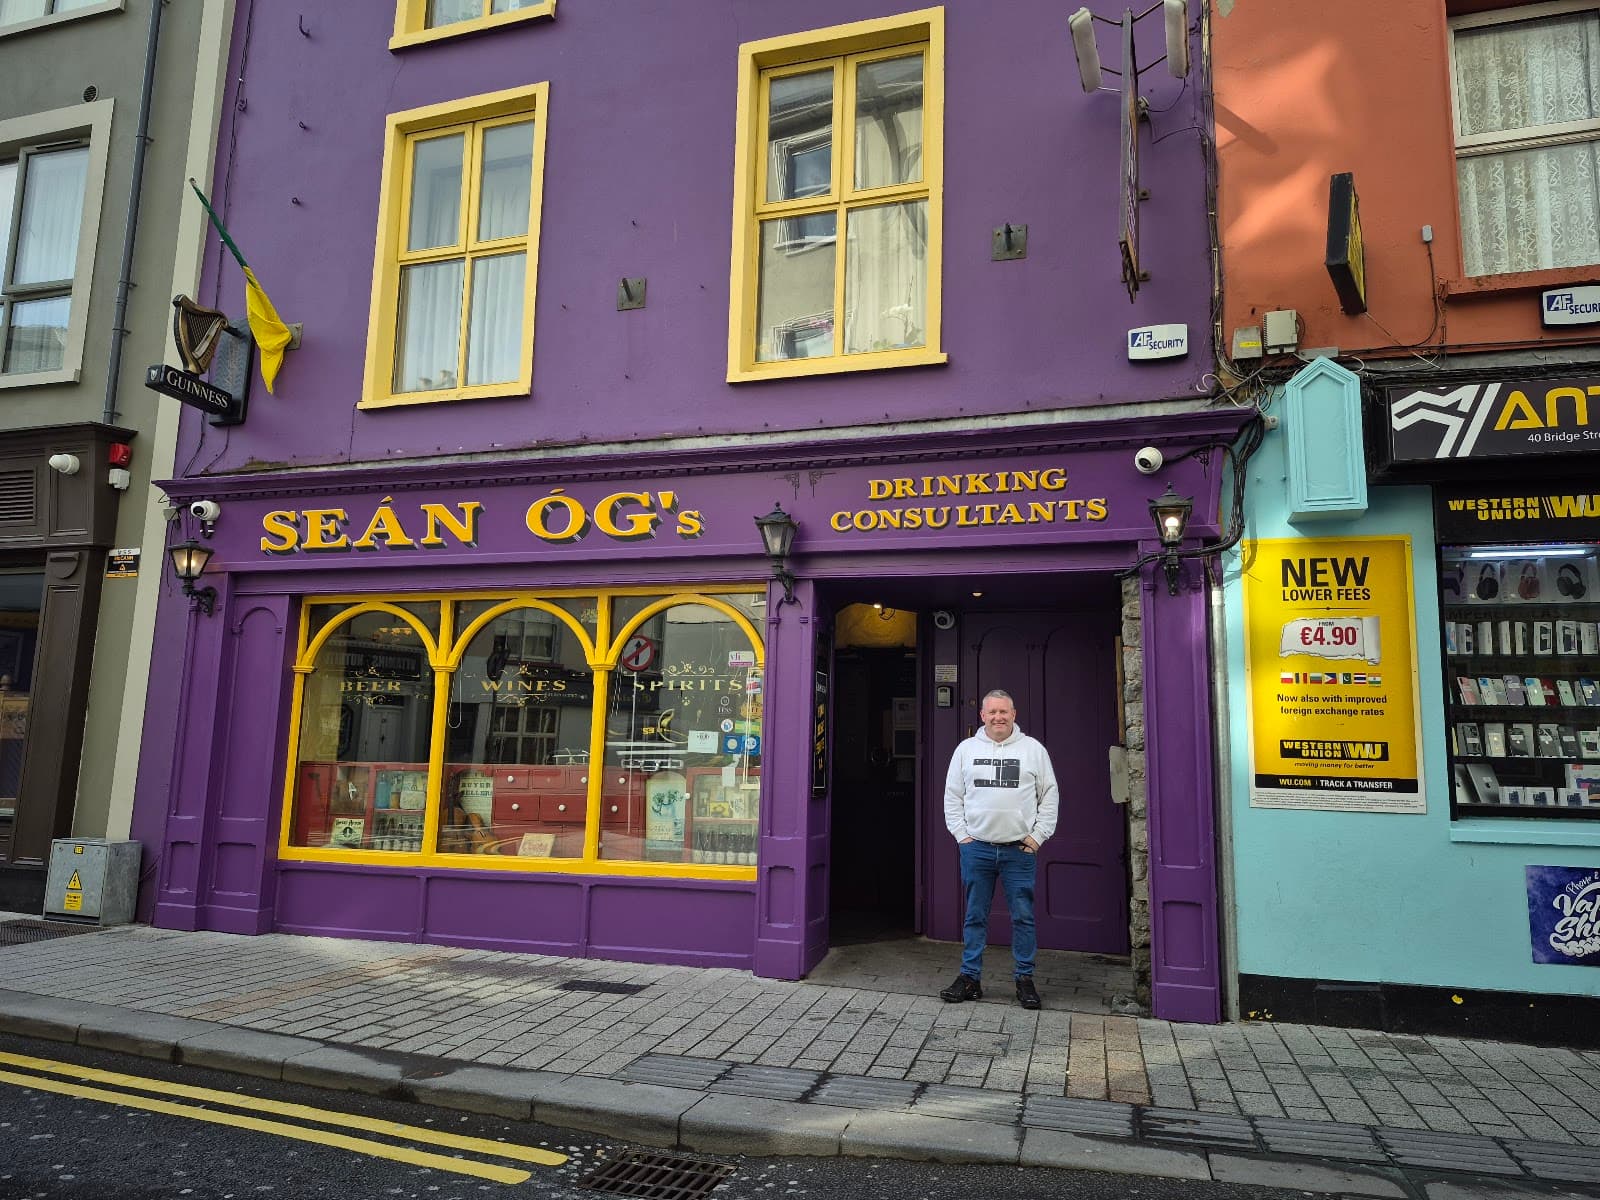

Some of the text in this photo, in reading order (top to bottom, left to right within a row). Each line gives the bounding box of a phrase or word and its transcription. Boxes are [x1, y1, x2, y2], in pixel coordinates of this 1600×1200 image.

[1149, 339, 1184, 350] SECURITY
[166, 370, 228, 408] GUINNESS
[1493, 386, 1600, 431] AN
[1528, 430, 1600, 443] 40 Bridge Str
[867, 468, 1068, 500] DRINKING
[1448, 497, 1539, 511] WESTERN
[830, 498, 1108, 532] CONSULTANTS
[1477, 508, 1540, 521] UNION
[259, 495, 483, 555] SEÁN
[1281, 556, 1370, 587] NEW
[1282, 588, 1371, 602] LOWER FEES
[339, 681, 401, 691] BEER
[481, 679, 566, 692] WINES
[633, 679, 743, 691] SPIRITS
[1277, 694, 1387, 705] Now also with improved
[1280, 706, 1385, 717] foreign exchange rates
[1283, 741, 1342, 750] WESTERN
[1348, 743, 1383, 759] WU
[1302, 748, 1342, 758] UNION
[1294, 761, 1318, 769] moving
[1279, 778, 1393, 789] WU.COM TRACK A TRANSFER
[1565, 876, 1592, 894] Phone
